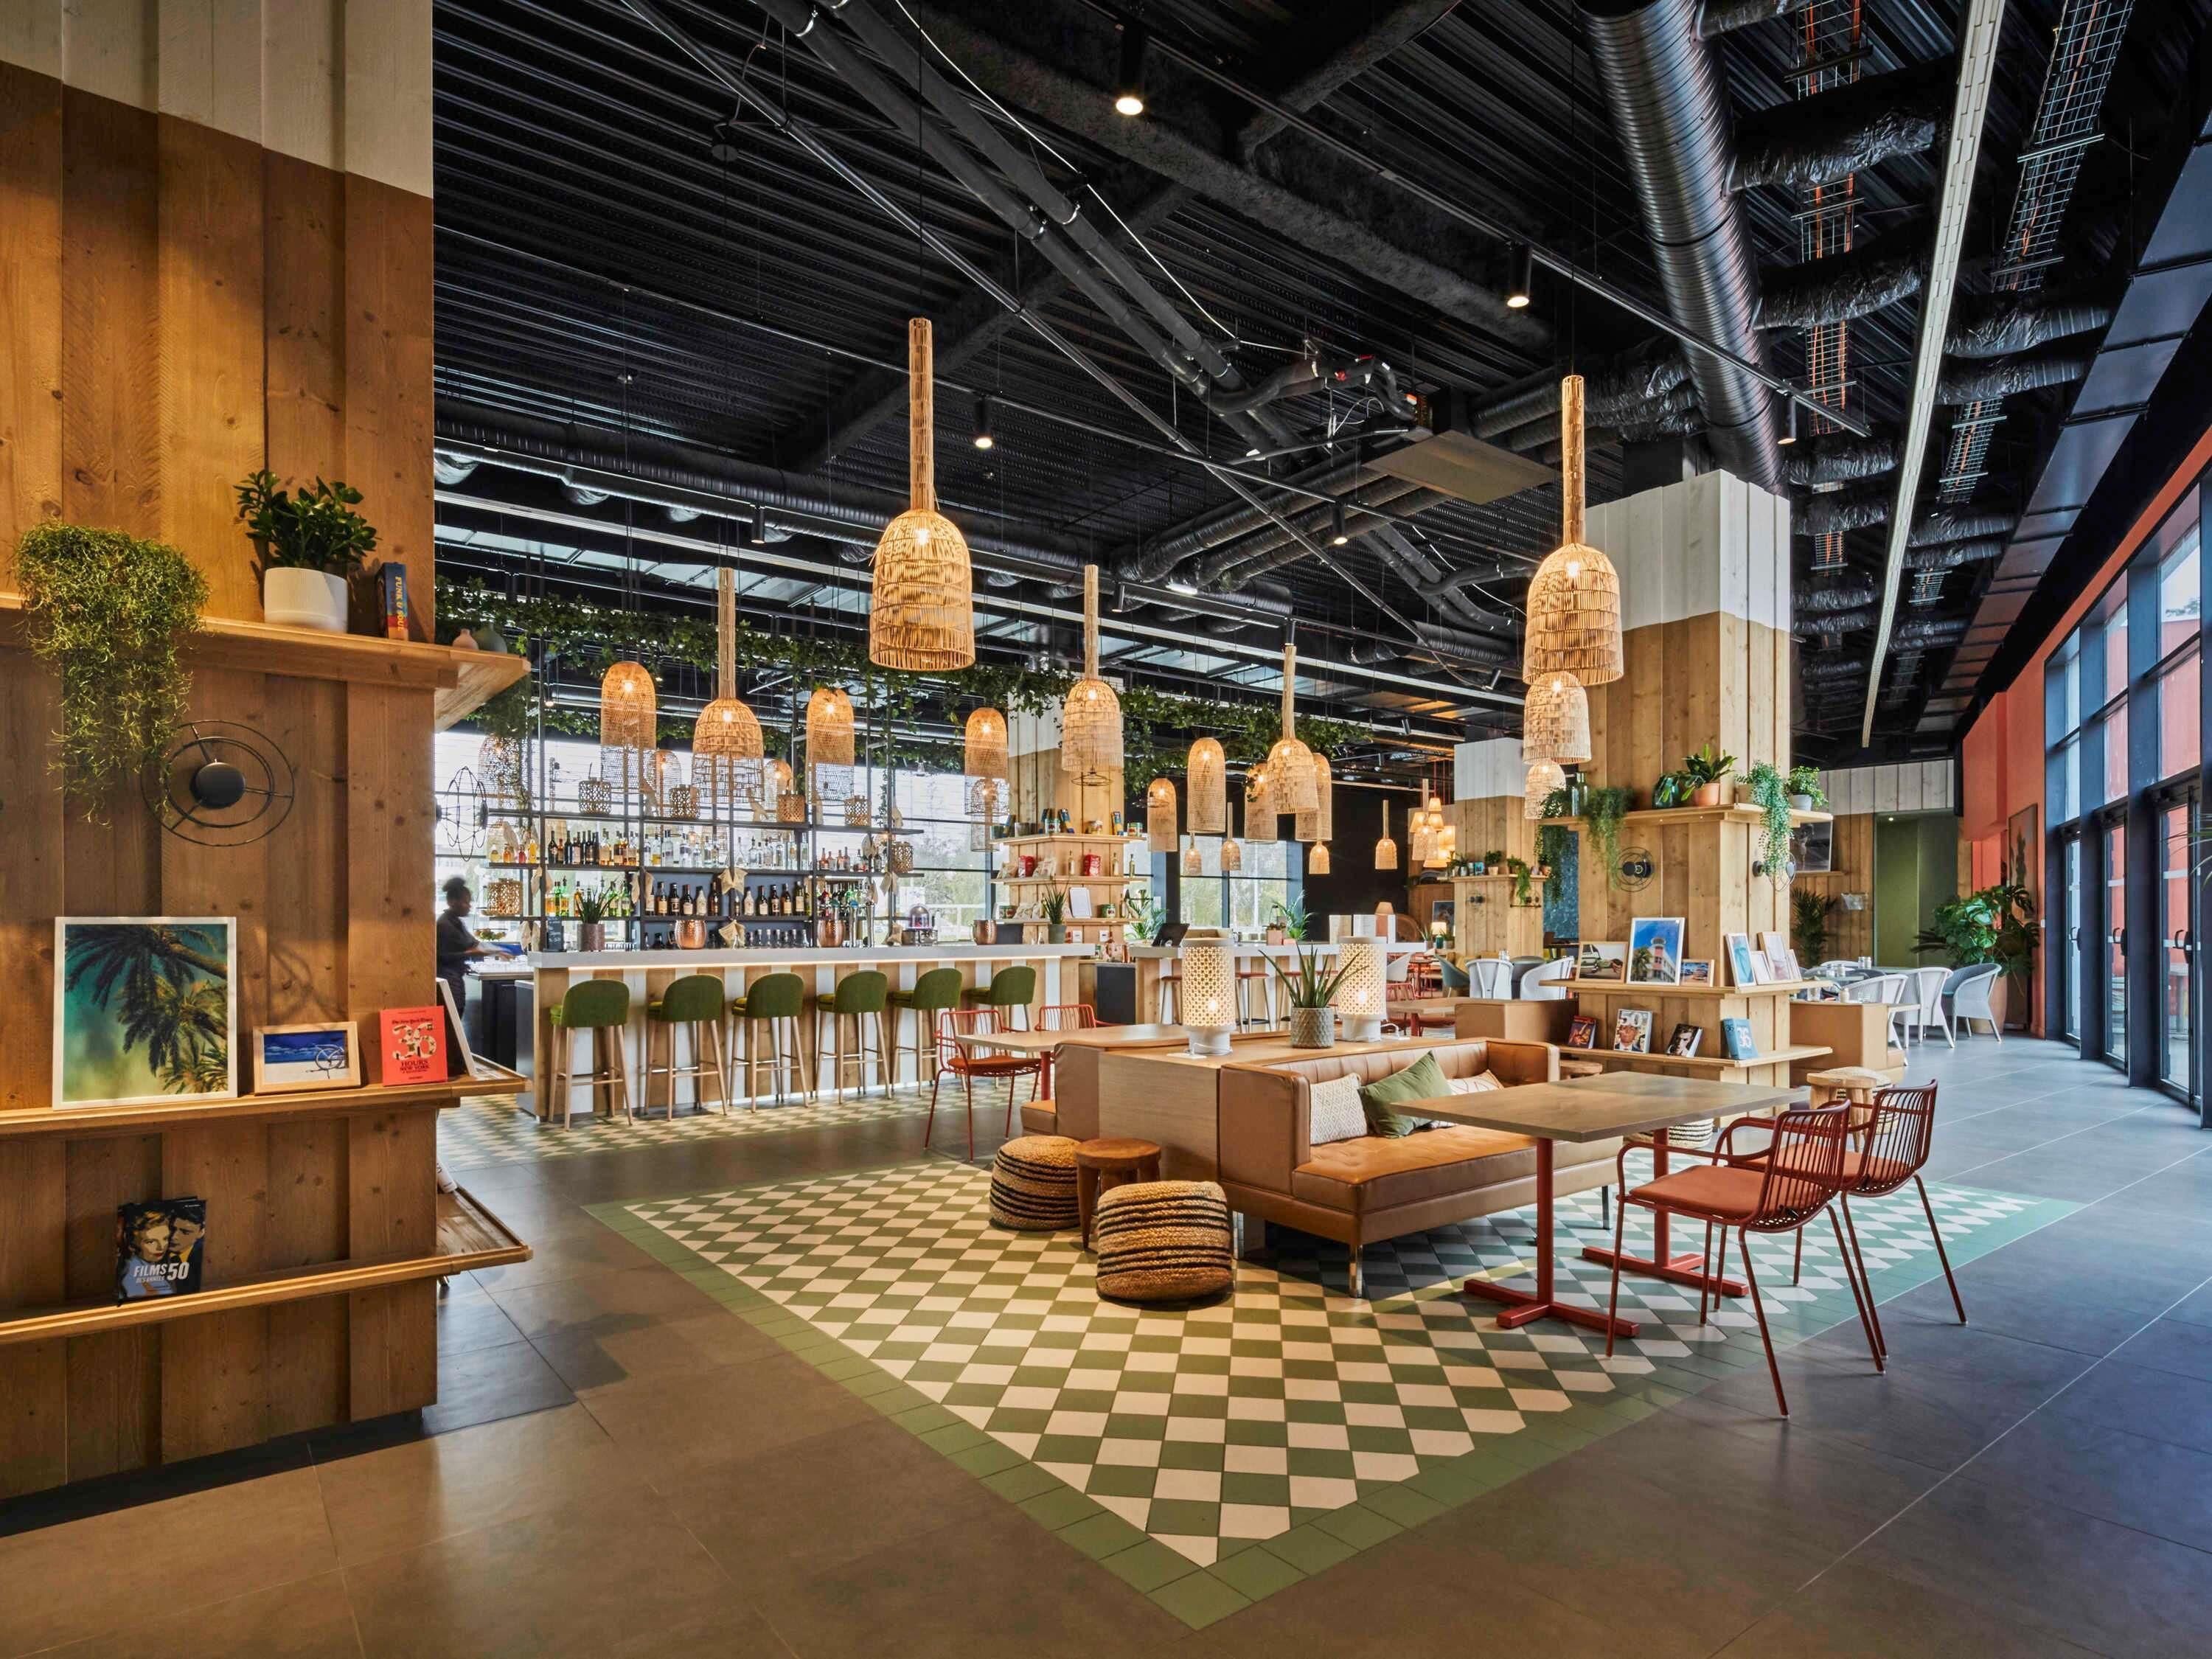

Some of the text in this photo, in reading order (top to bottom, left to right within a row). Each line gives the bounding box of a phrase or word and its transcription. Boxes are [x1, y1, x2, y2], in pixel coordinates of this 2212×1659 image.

[392, 1023, 437, 1060] 36
[1737, 1026, 1752, 1048] 36
[401, 1060, 428, 1068] HOURS
[133, 1264, 167, 1277] FILMS
[167, 1262, 189, 1281] 50
